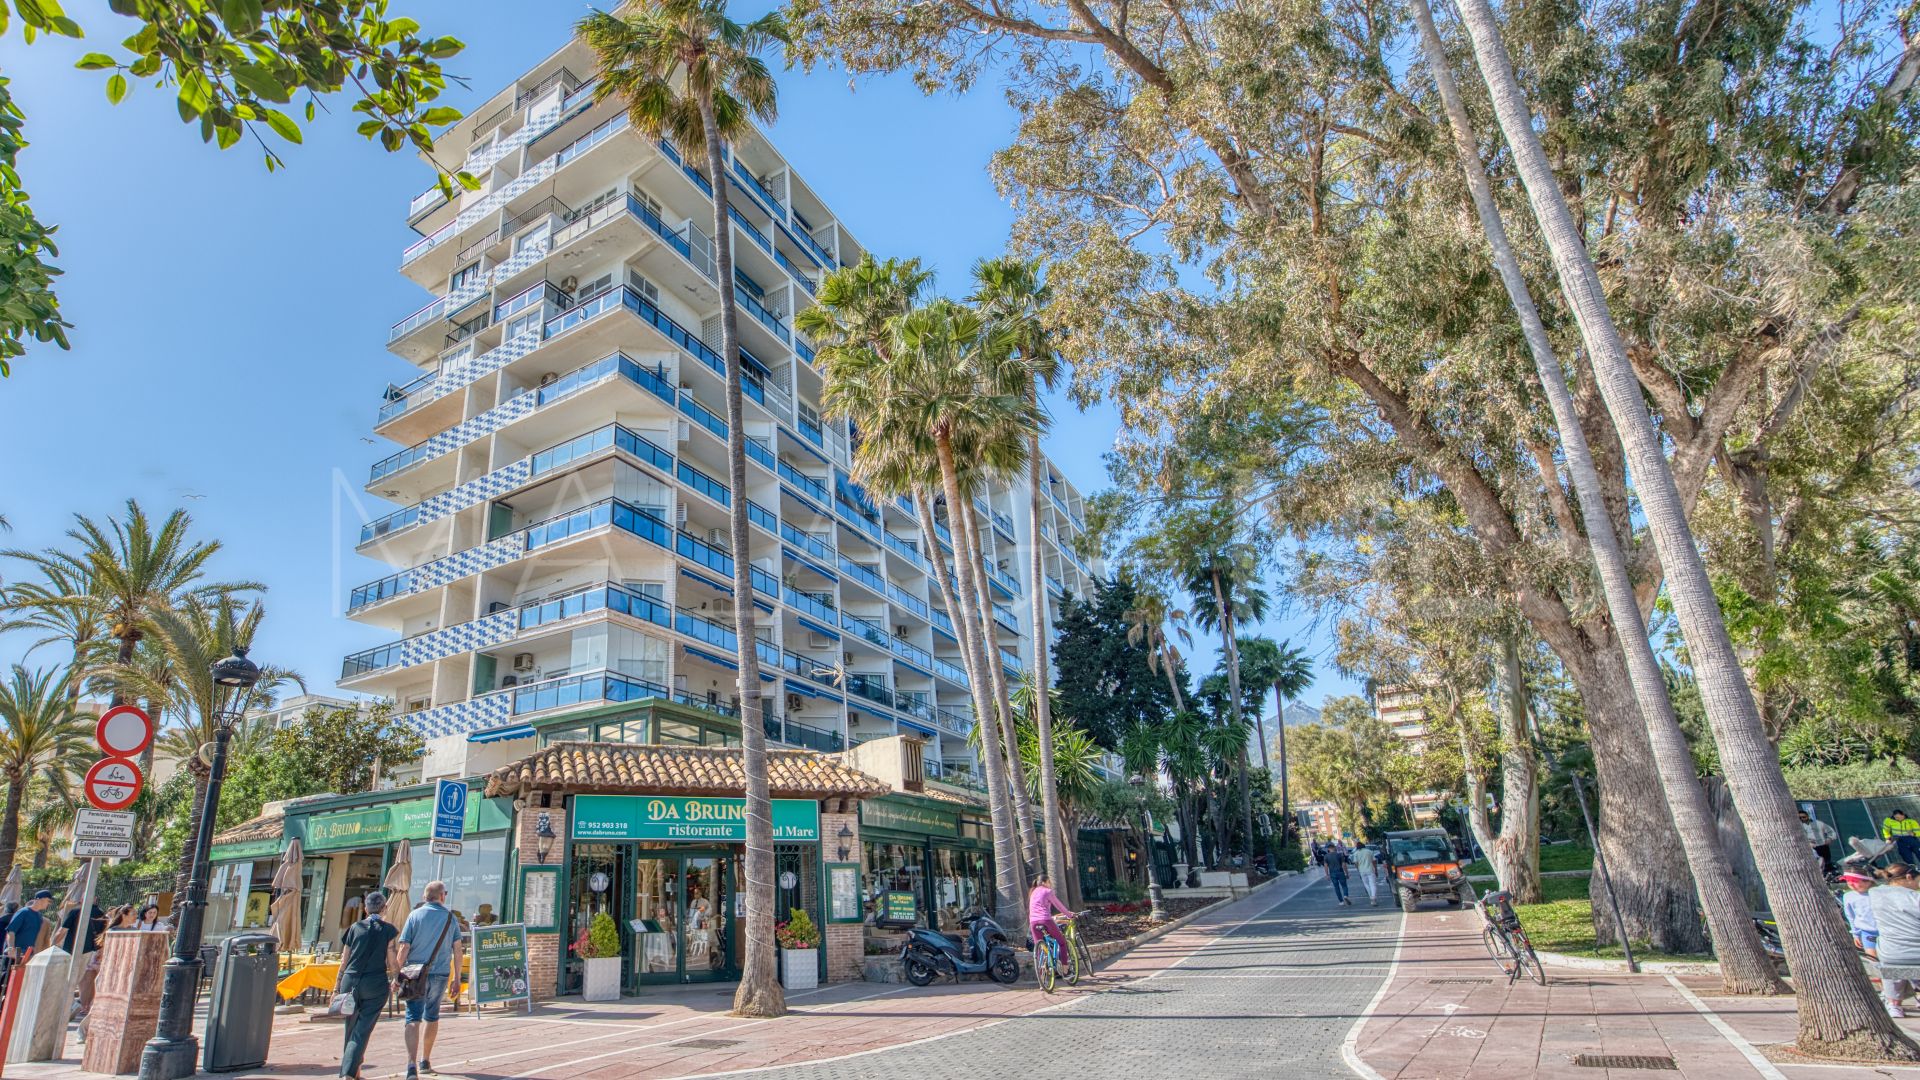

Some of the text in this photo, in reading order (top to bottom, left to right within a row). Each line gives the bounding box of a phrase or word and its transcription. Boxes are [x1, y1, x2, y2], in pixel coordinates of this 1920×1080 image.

[647, 799, 681, 821] DA
[314, 824, 328, 841] DA
[329, 821, 361, 839] BRUNO
[588, 821, 628, 829] 952 903 318
[668, 823, 814, 837] ristorante ul Mare
[492, 931, 507, 939] THE
